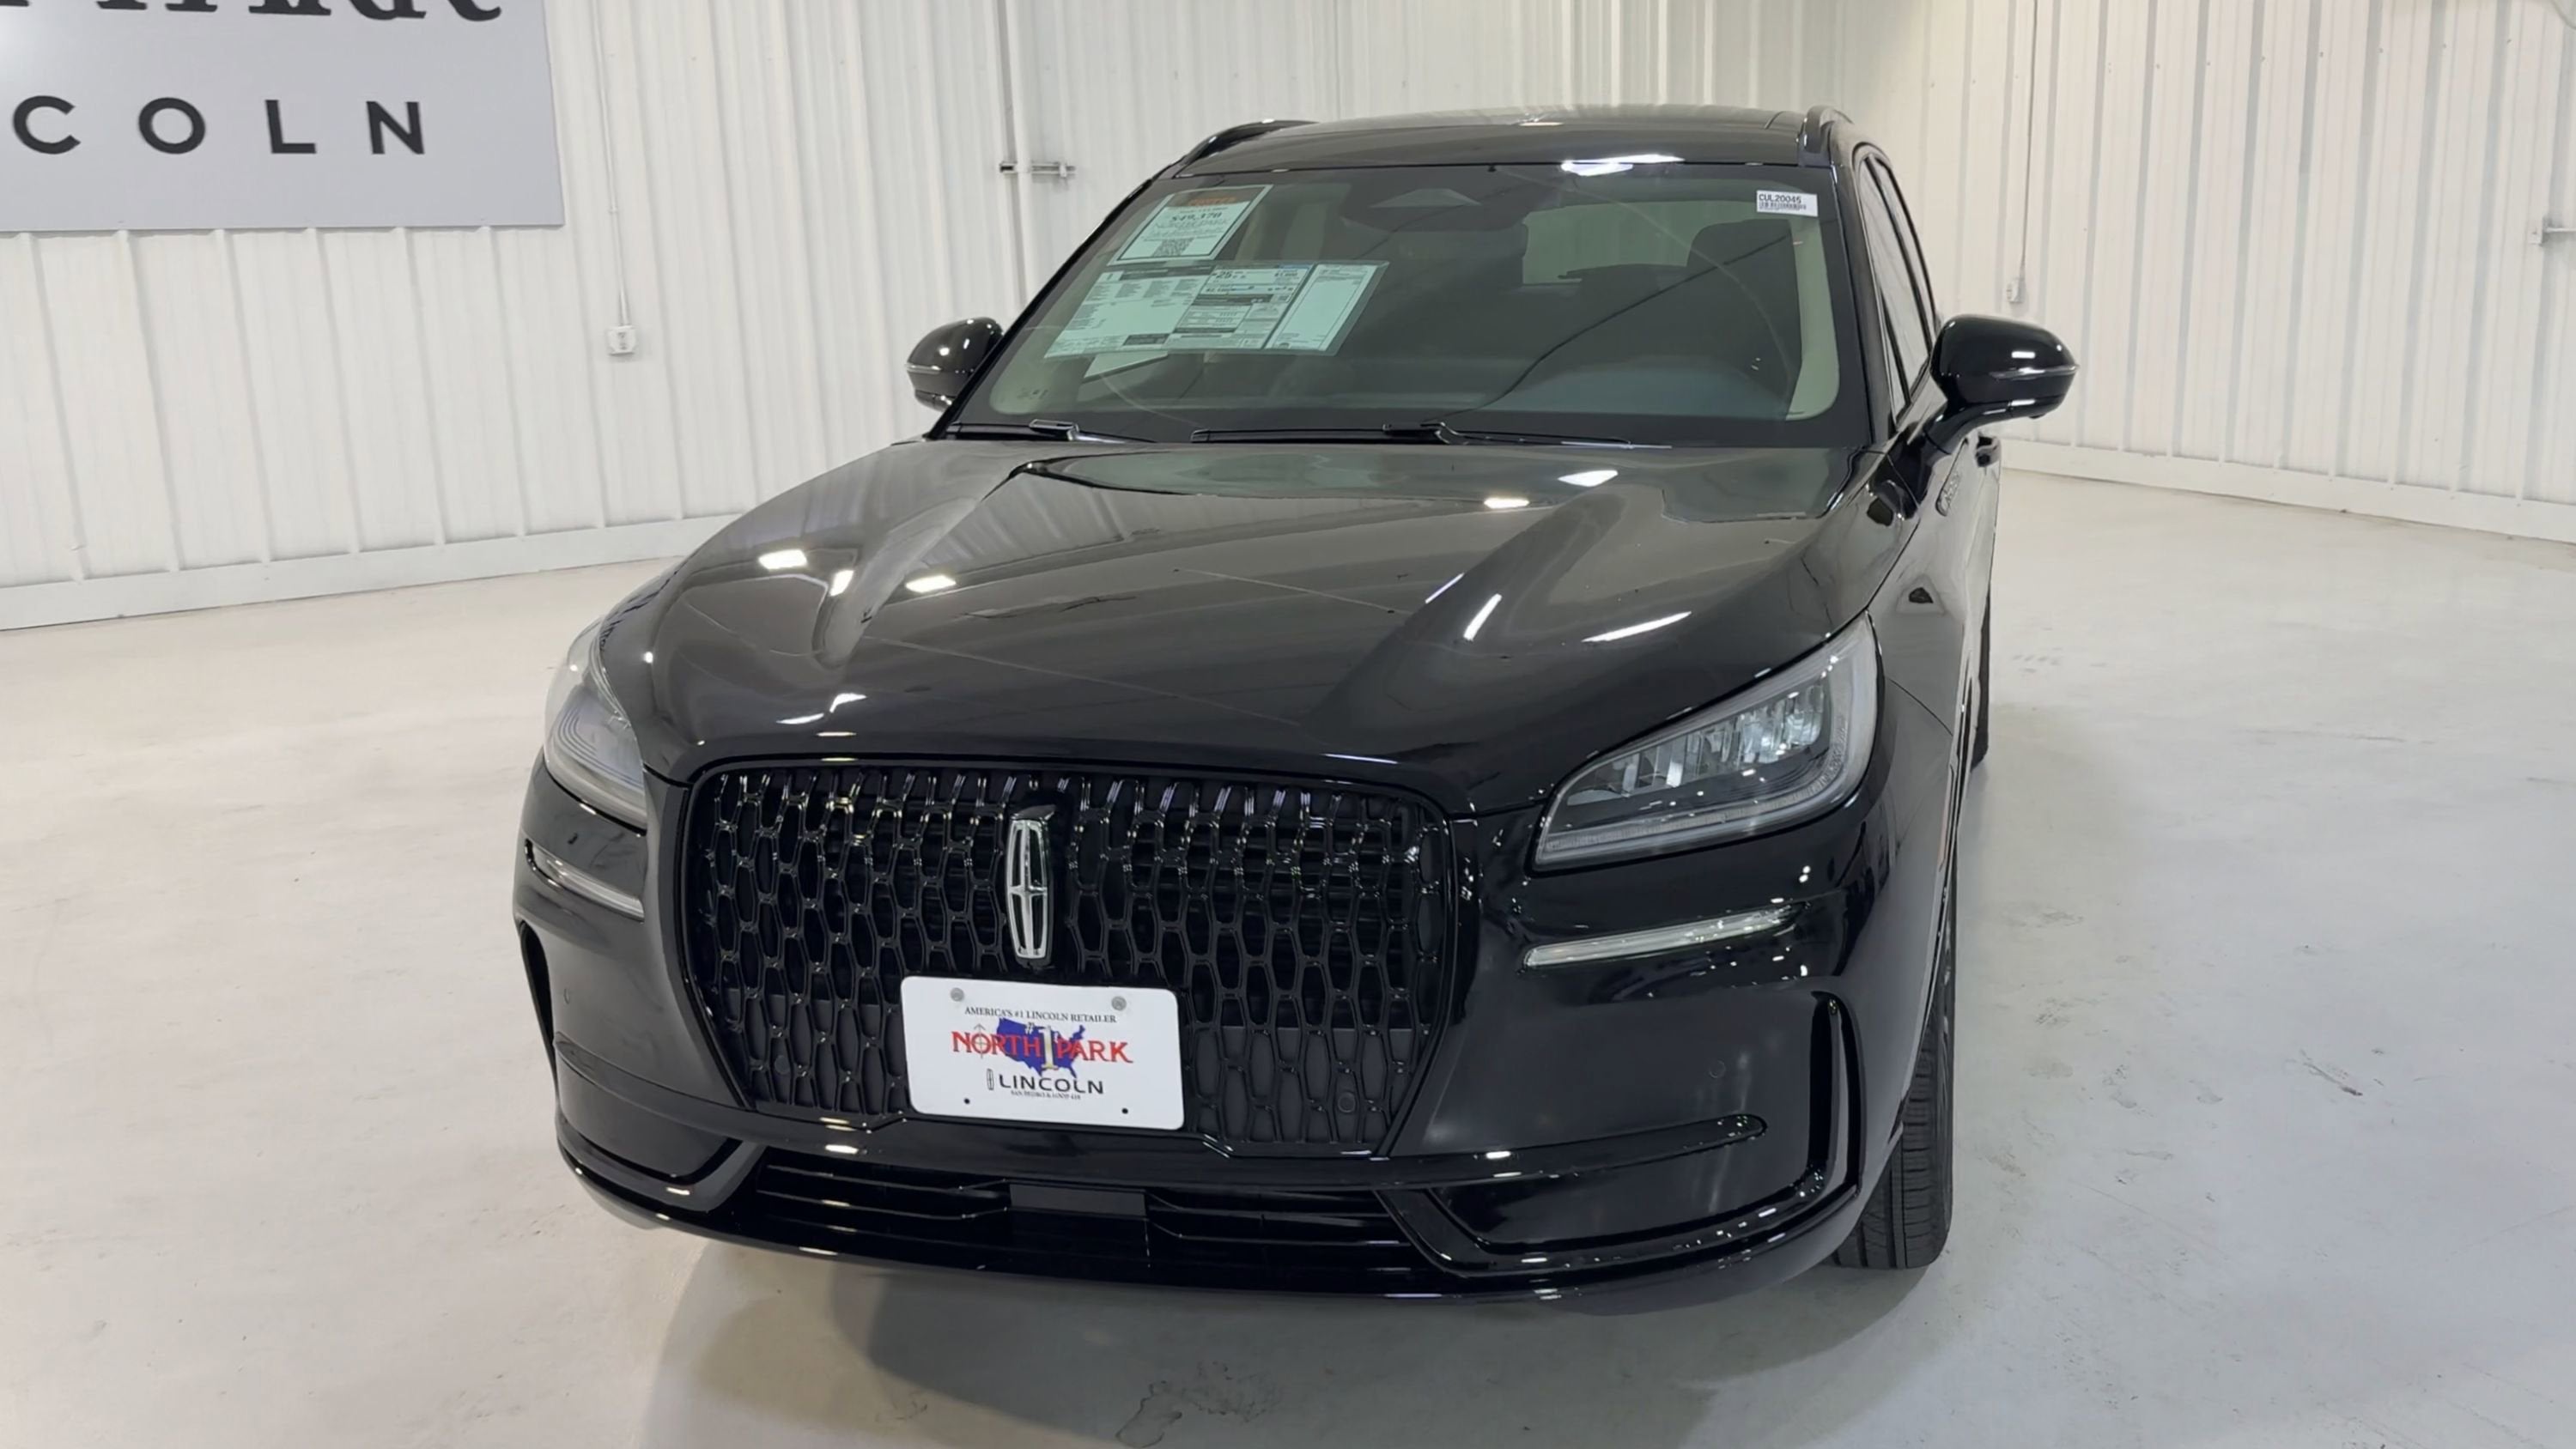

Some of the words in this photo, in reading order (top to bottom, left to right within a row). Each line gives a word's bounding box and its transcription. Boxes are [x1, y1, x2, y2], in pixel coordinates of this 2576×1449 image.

[964, 1006, 1013, 1017] AMERICA'S
[1026, 1010, 1069, 1022] LINCOLN
[1071, 1013, 1116, 1023] RETAILER
[951, 1031, 1042, 1058] NORTH
[1056, 1037, 1133, 1064] PARK
[999, 1074, 1103, 1094] LINCOLN
